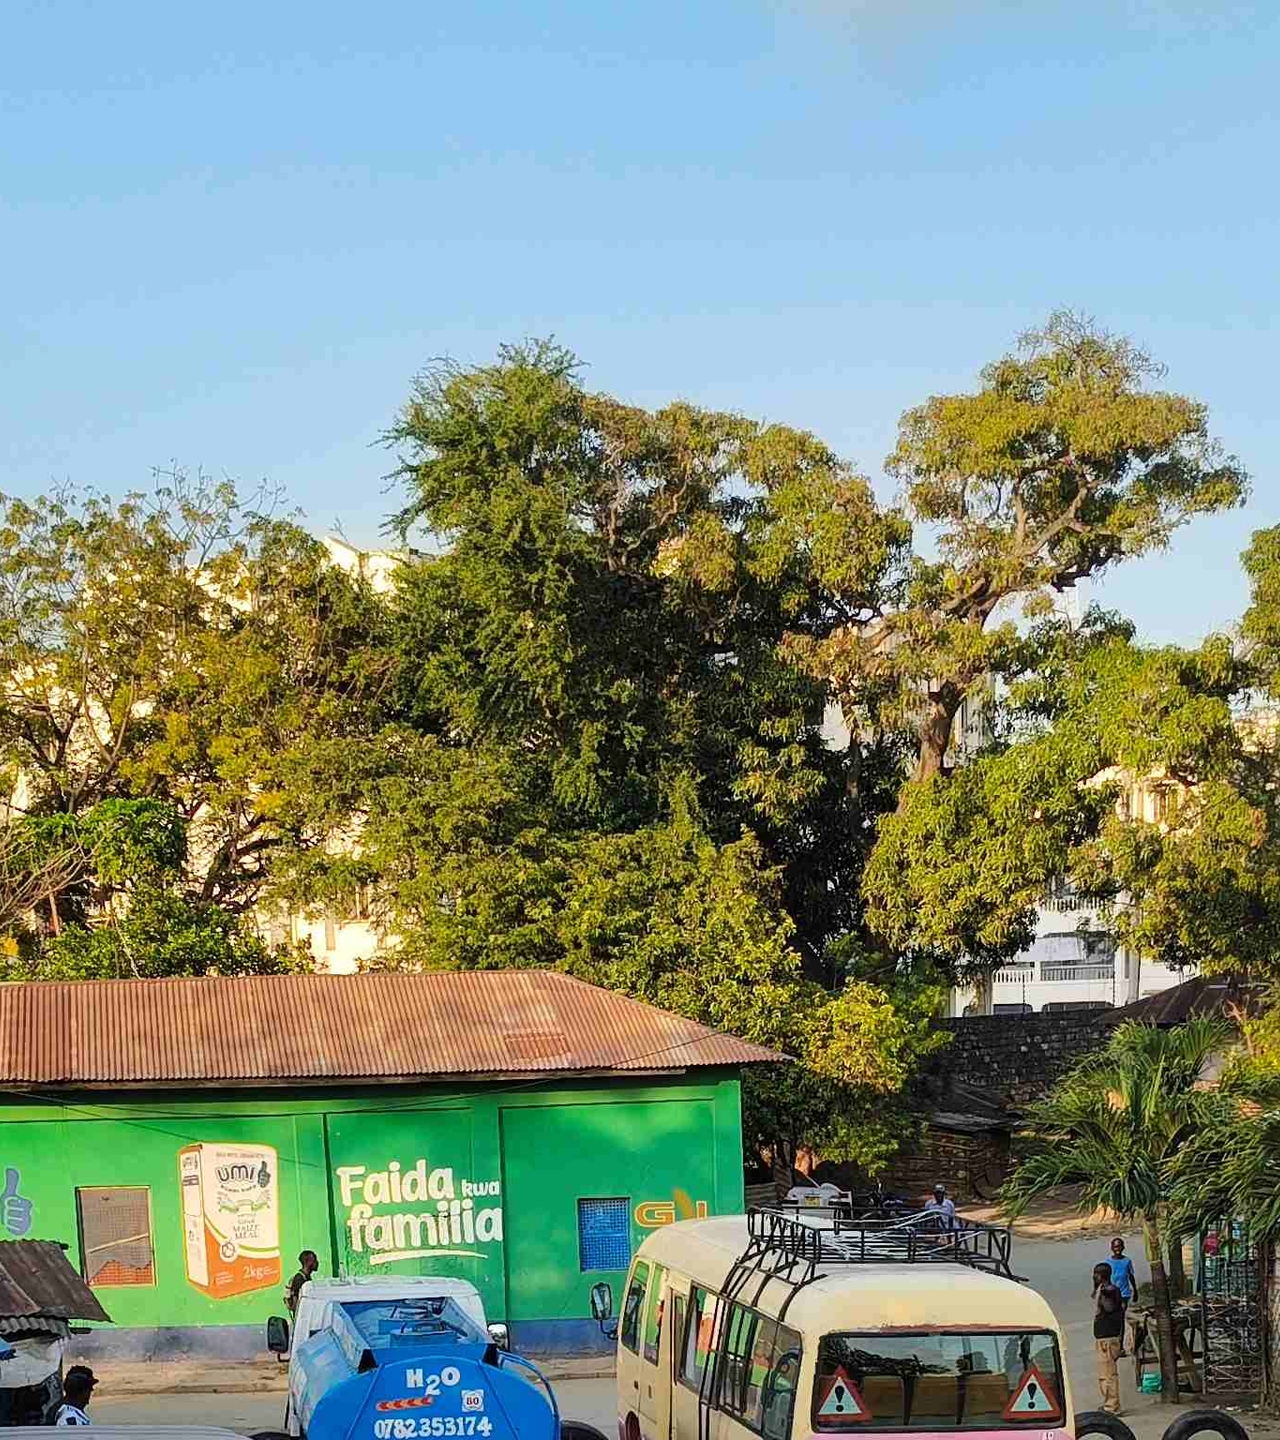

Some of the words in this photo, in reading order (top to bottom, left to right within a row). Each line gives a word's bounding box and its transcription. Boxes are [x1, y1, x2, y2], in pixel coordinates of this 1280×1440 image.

[336, 1159, 455, 1207] Faida
[461, 1179, 500, 1197] kwa
[347, 1199, 503, 1252] familia
[406, 1366, 460, 1396] H2O
